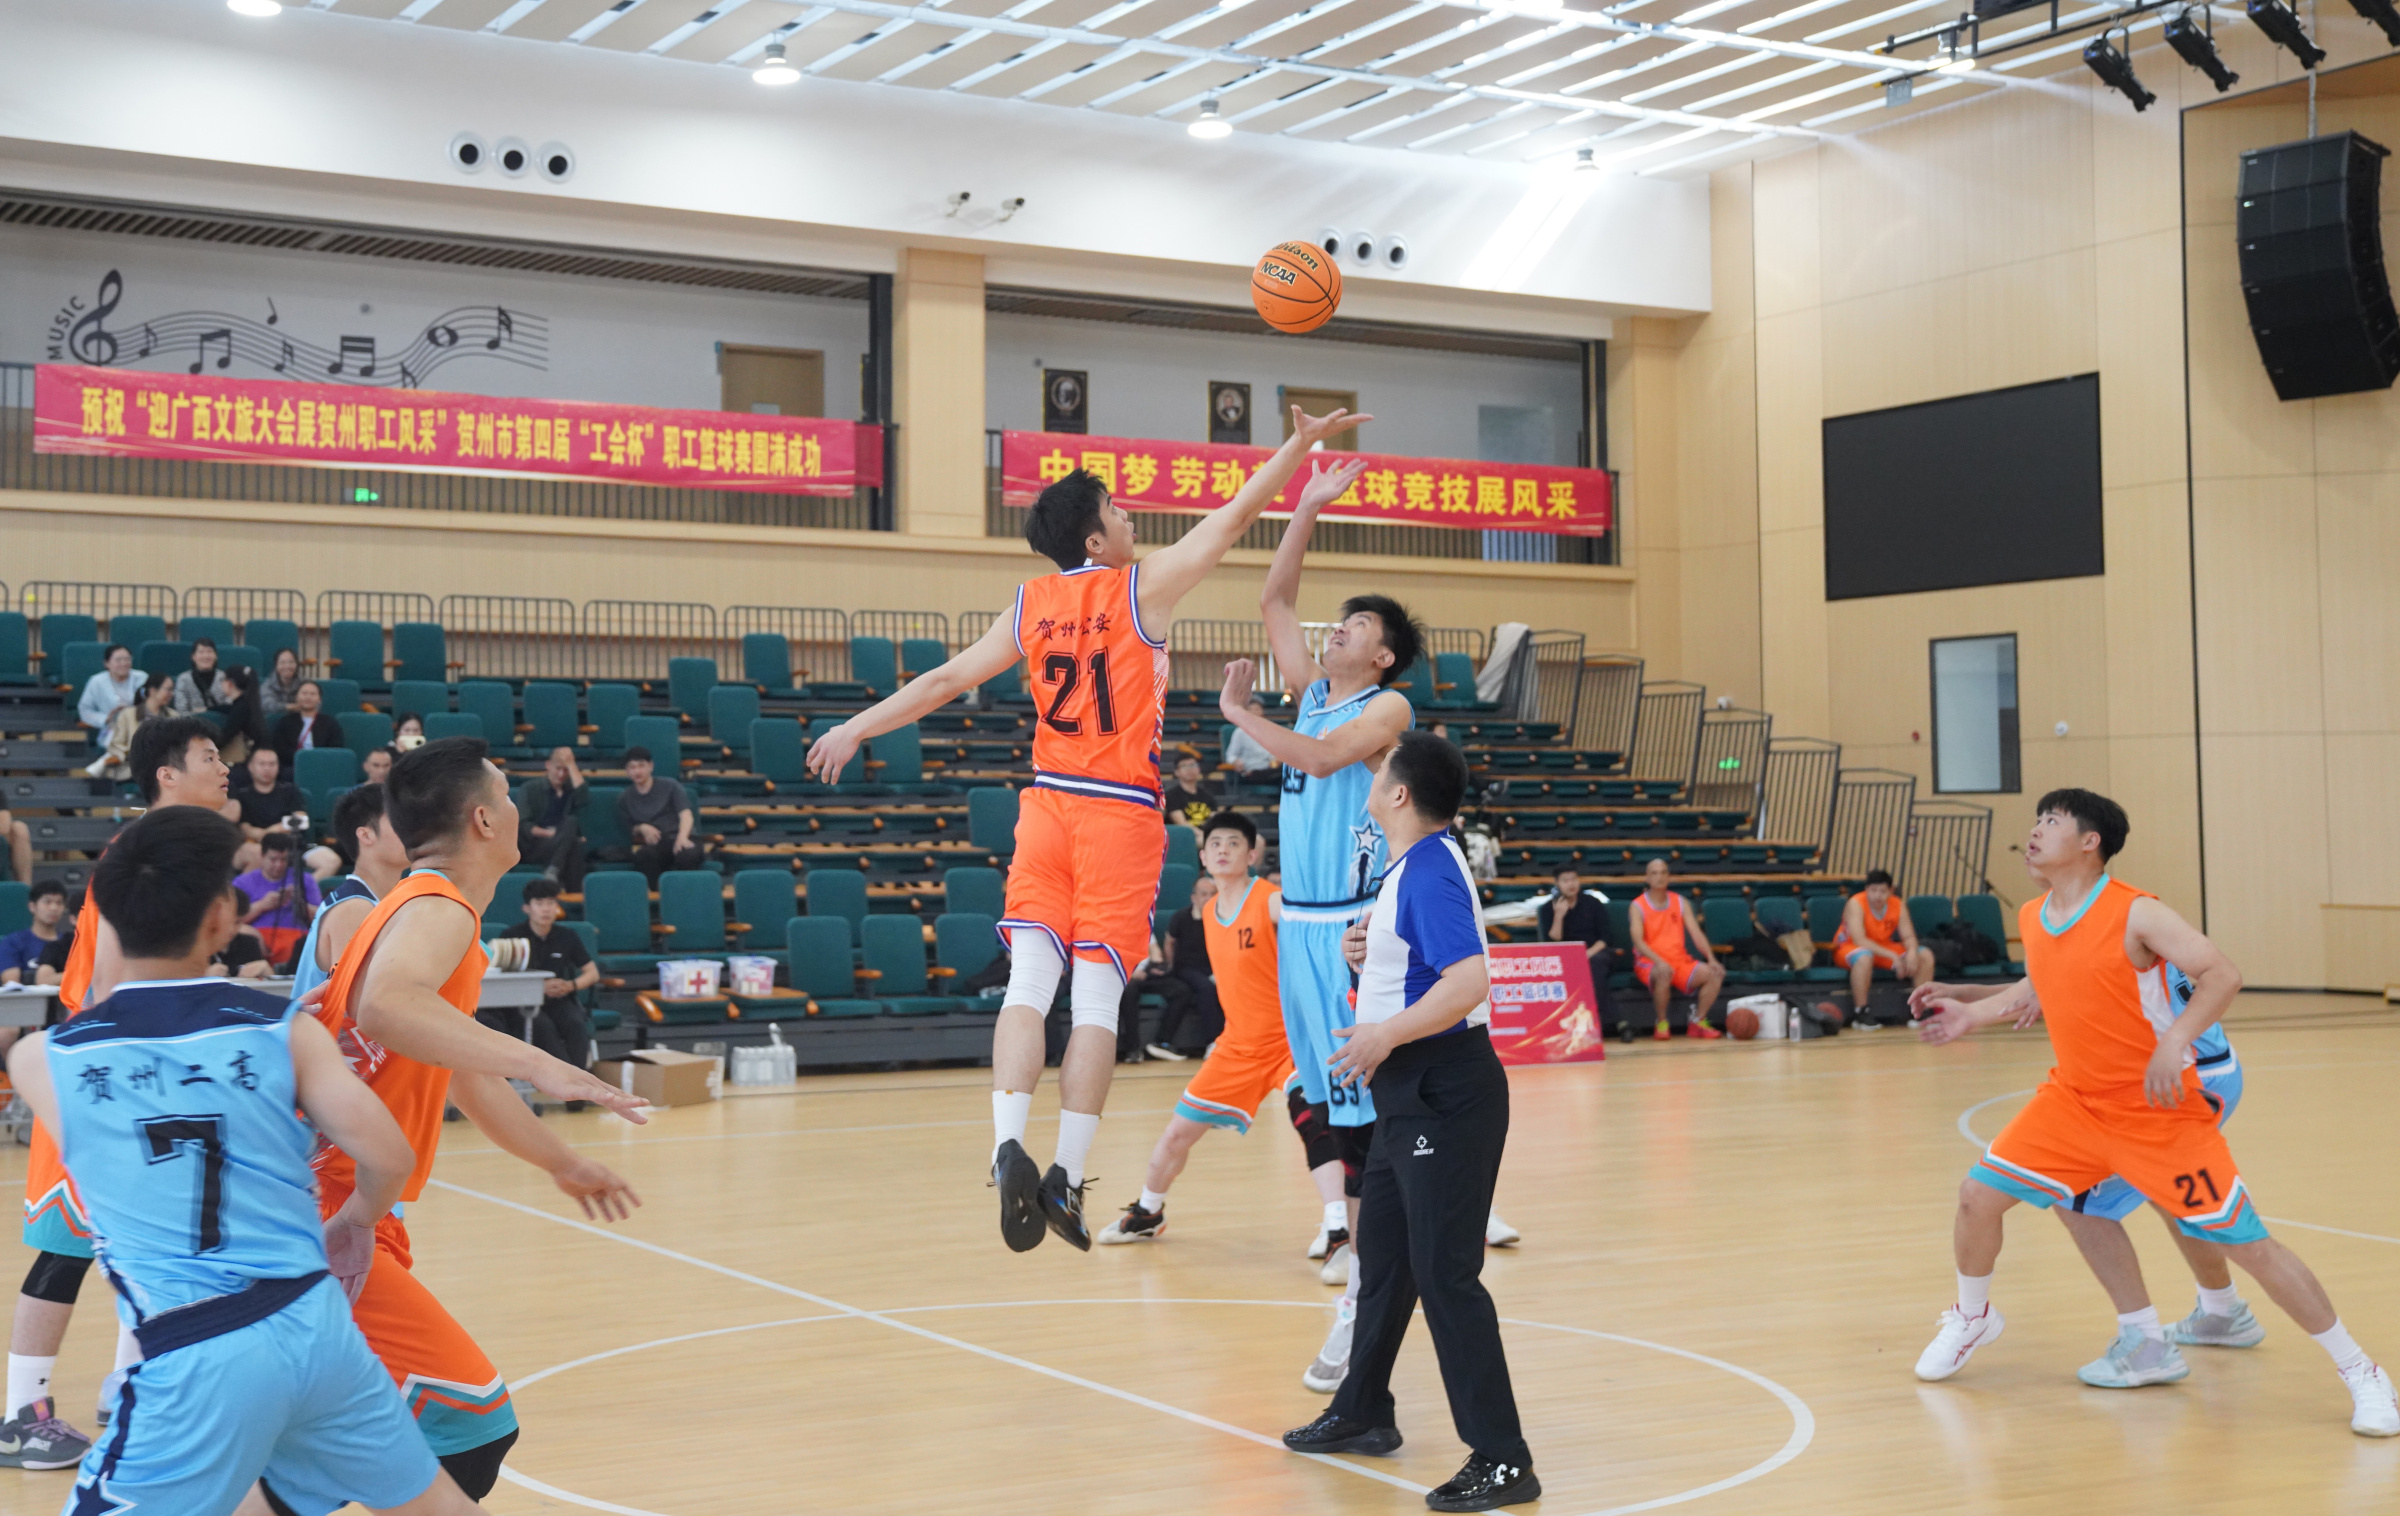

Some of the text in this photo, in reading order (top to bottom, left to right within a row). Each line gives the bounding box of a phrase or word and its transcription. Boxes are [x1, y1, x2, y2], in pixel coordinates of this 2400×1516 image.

[1259, 260, 1298, 286] NCAA
[46, 295, 86, 360] MUSIC
[1039, 448, 1159, 496] 中国梦
[1171, 456, 1286, 504] 劳动
[1035, 612, 1111, 641] 贺州公安
[1040, 646, 1118, 736] 21
[1237, 927, 1256, 950] 12
[75, 1050, 259, 1105] 贺州二高
[132, 1113, 232, 1256] 7
[2174, 1167, 2221, 1208] 21
